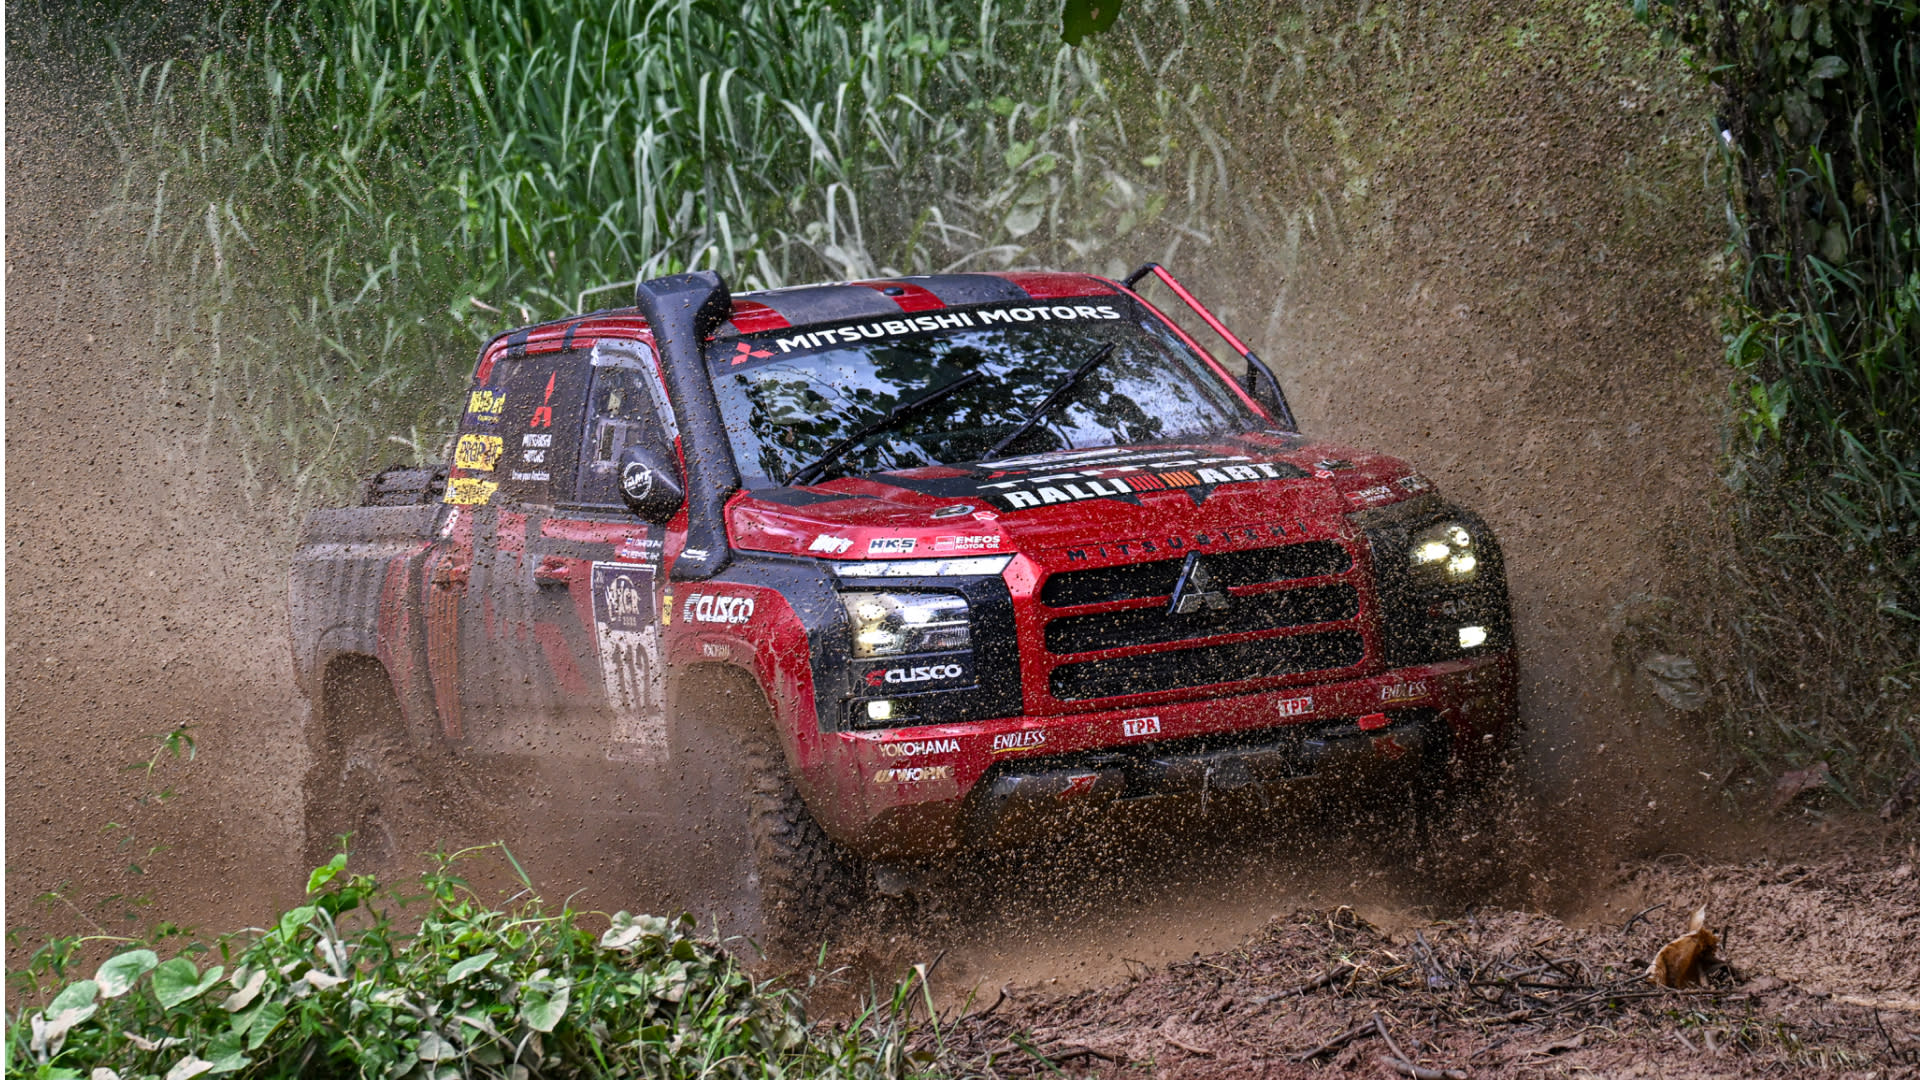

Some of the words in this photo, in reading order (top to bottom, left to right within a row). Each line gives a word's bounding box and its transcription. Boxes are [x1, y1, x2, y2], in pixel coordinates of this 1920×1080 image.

[775, 311, 974, 354] MITSUBISHI
[983, 304, 1121, 326] MOTORS
[1003, 478, 1132, 508] RALLI
[869, 538, 915, 549] HKS
[955, 535, 1001, 544] ENEOS
[1066, 521, 1308, 562] MITSUBISHI
[695, 594, 755, 624] CUSCO
[885, 663, 963, 685] CUSCO
[1127, 717, 1159, 735] TPR
[878, 738, 961, 758] YOKOHAMA
[993, 729, 1047, 750] ENDLESS
